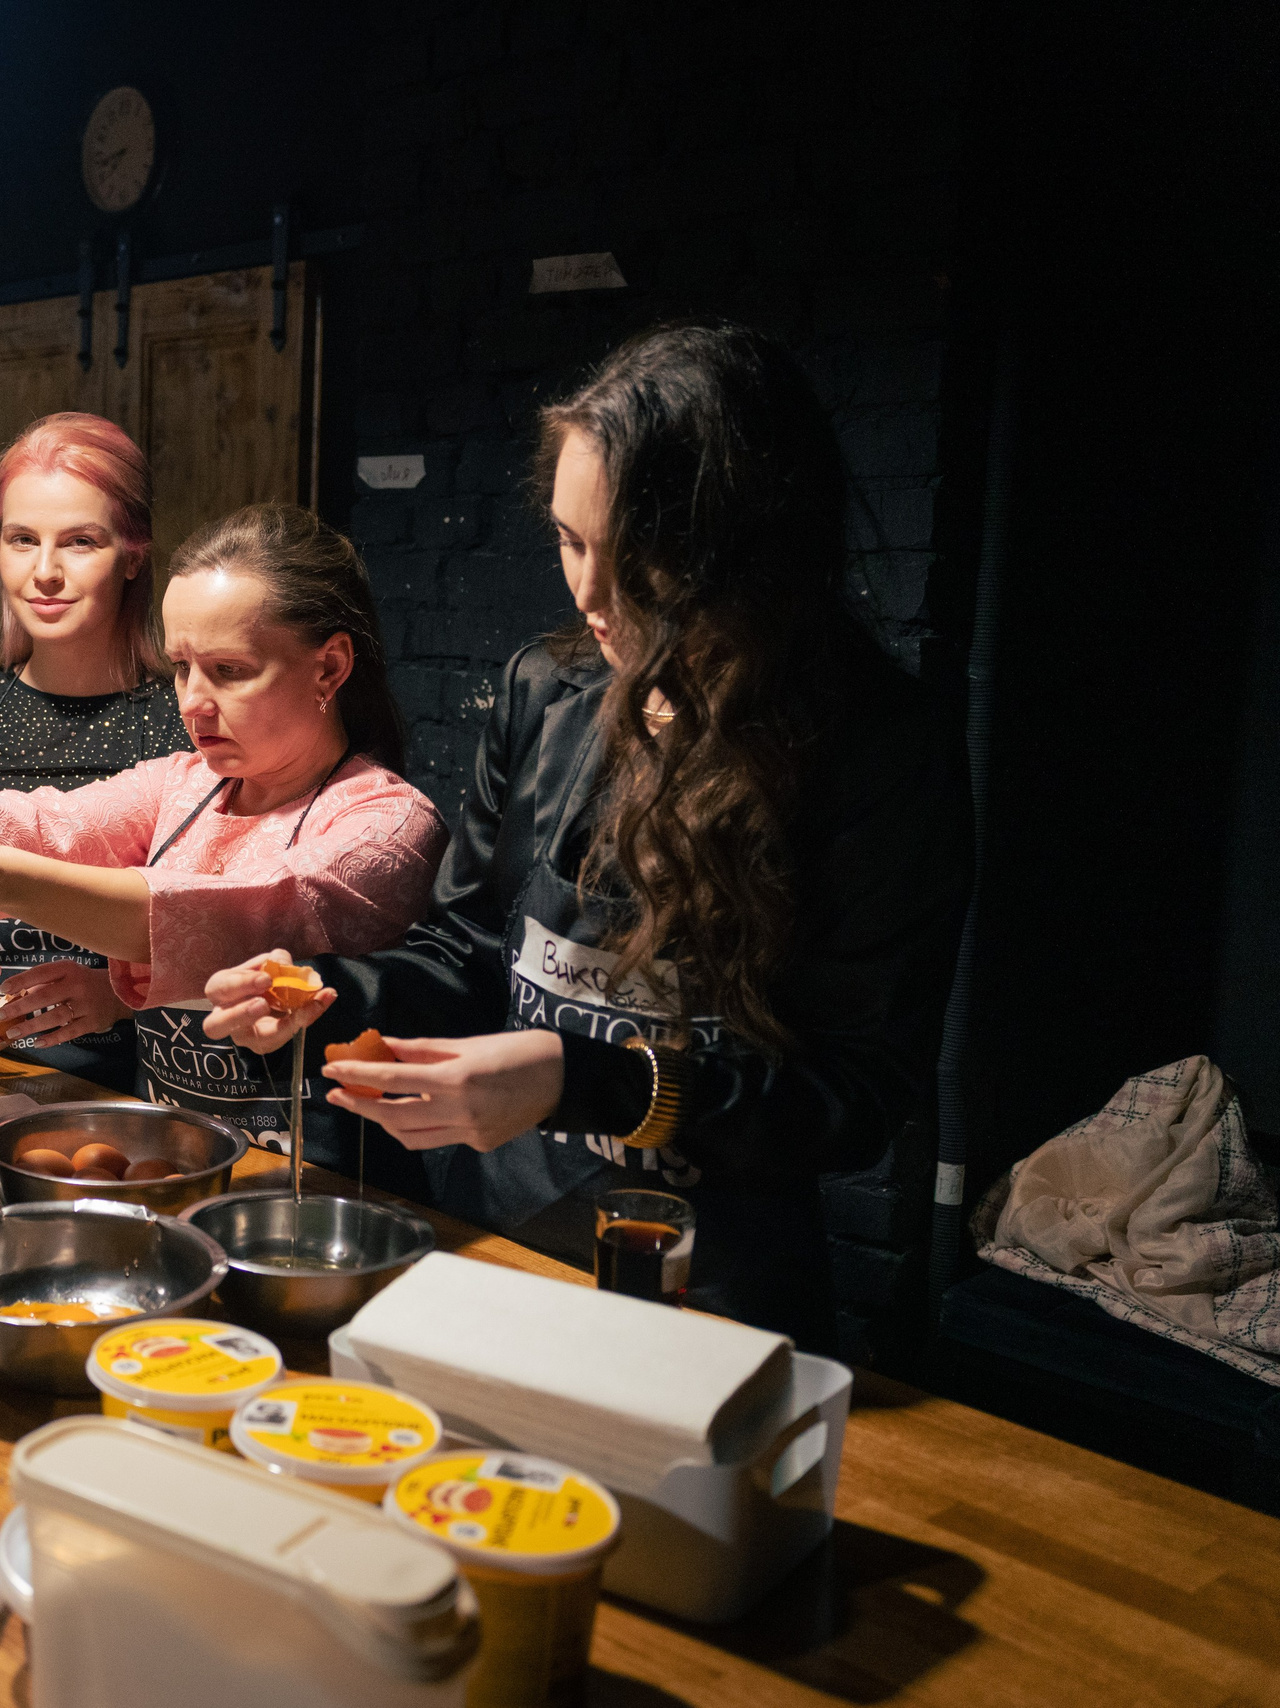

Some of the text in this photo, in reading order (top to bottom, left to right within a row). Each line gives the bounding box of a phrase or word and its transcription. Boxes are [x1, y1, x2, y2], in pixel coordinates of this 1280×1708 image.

[10, 928, 94, 955] СТО
[207, 1083, 257, 1096] СТУДИЯ
[222, 1115, 277, 1128] since 1889
